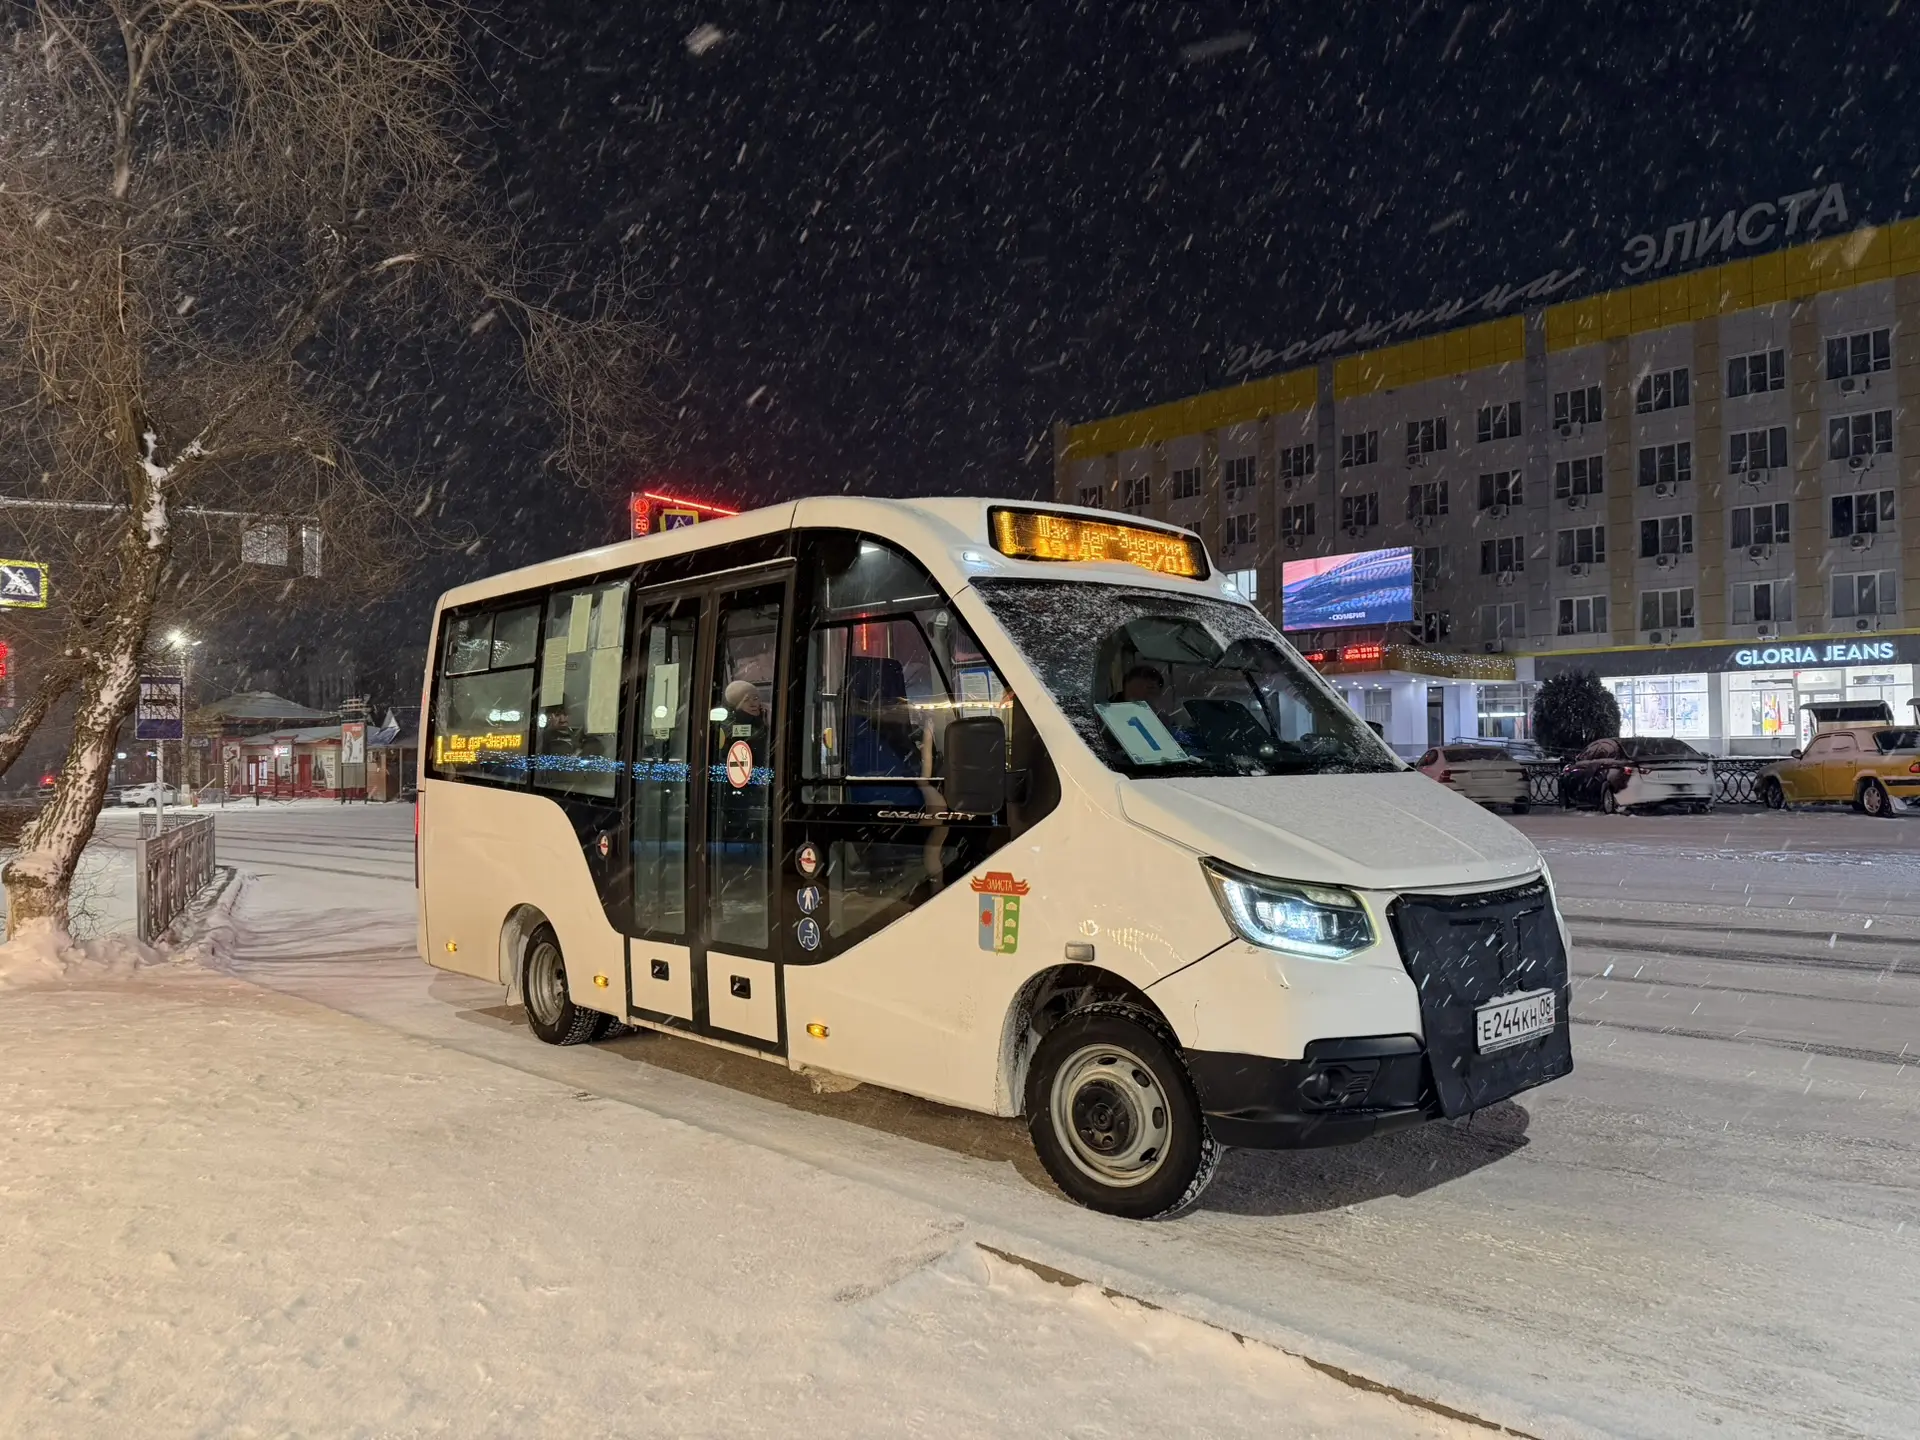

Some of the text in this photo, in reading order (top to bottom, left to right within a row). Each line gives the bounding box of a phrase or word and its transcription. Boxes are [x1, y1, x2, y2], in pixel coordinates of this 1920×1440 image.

[1620, 182, 1850, 276] ЭЛИСТА
[1735, 642, 1894, 666] GLORIA JEANS
[1125, 716, 1162, 751] 1
[436, 735, 443, 764] 1
[986, 878, 1013, 892] ЭЛИСТА
